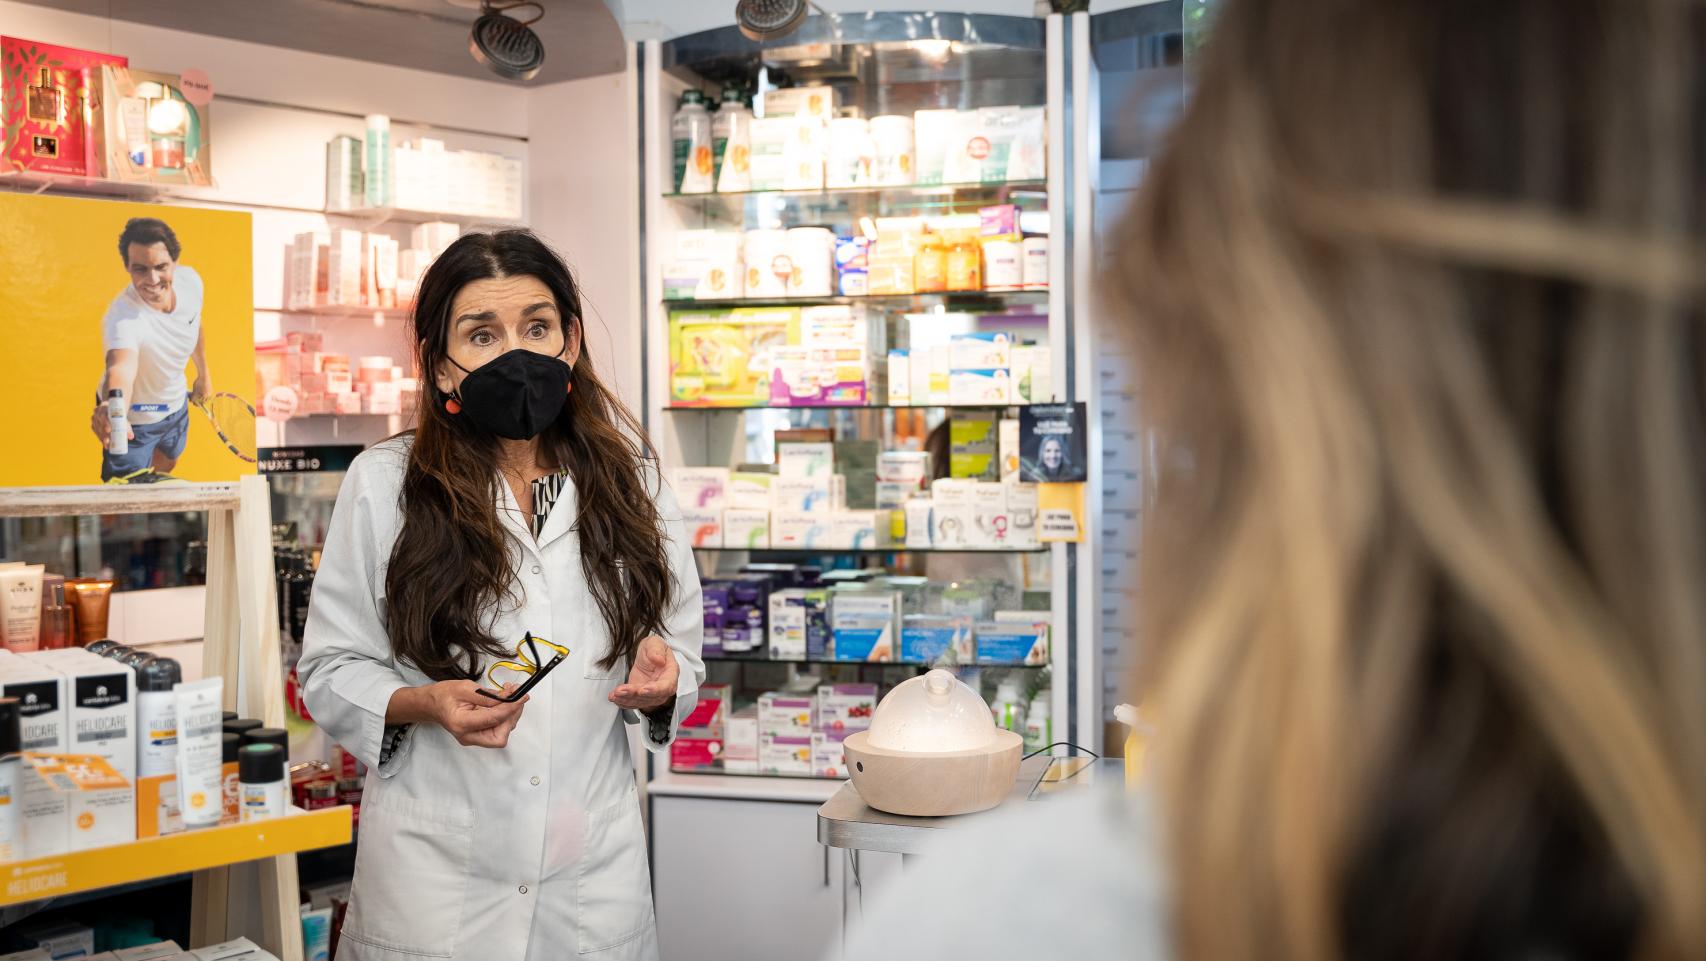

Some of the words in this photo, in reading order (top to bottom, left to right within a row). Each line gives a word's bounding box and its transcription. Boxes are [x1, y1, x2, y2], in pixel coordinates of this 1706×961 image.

[140, 403, 160, 412] SPORT
[257, 459, 293, 471] NUXE
[295, 458, 321, 470] BIO
[24, 722, 58, 739] IOCARE
[76, 715, 128, 735] HELIOCARE
[150, 719, 177, 729] HELIOC
[7, 871, 68, 896] HELIOCARE
